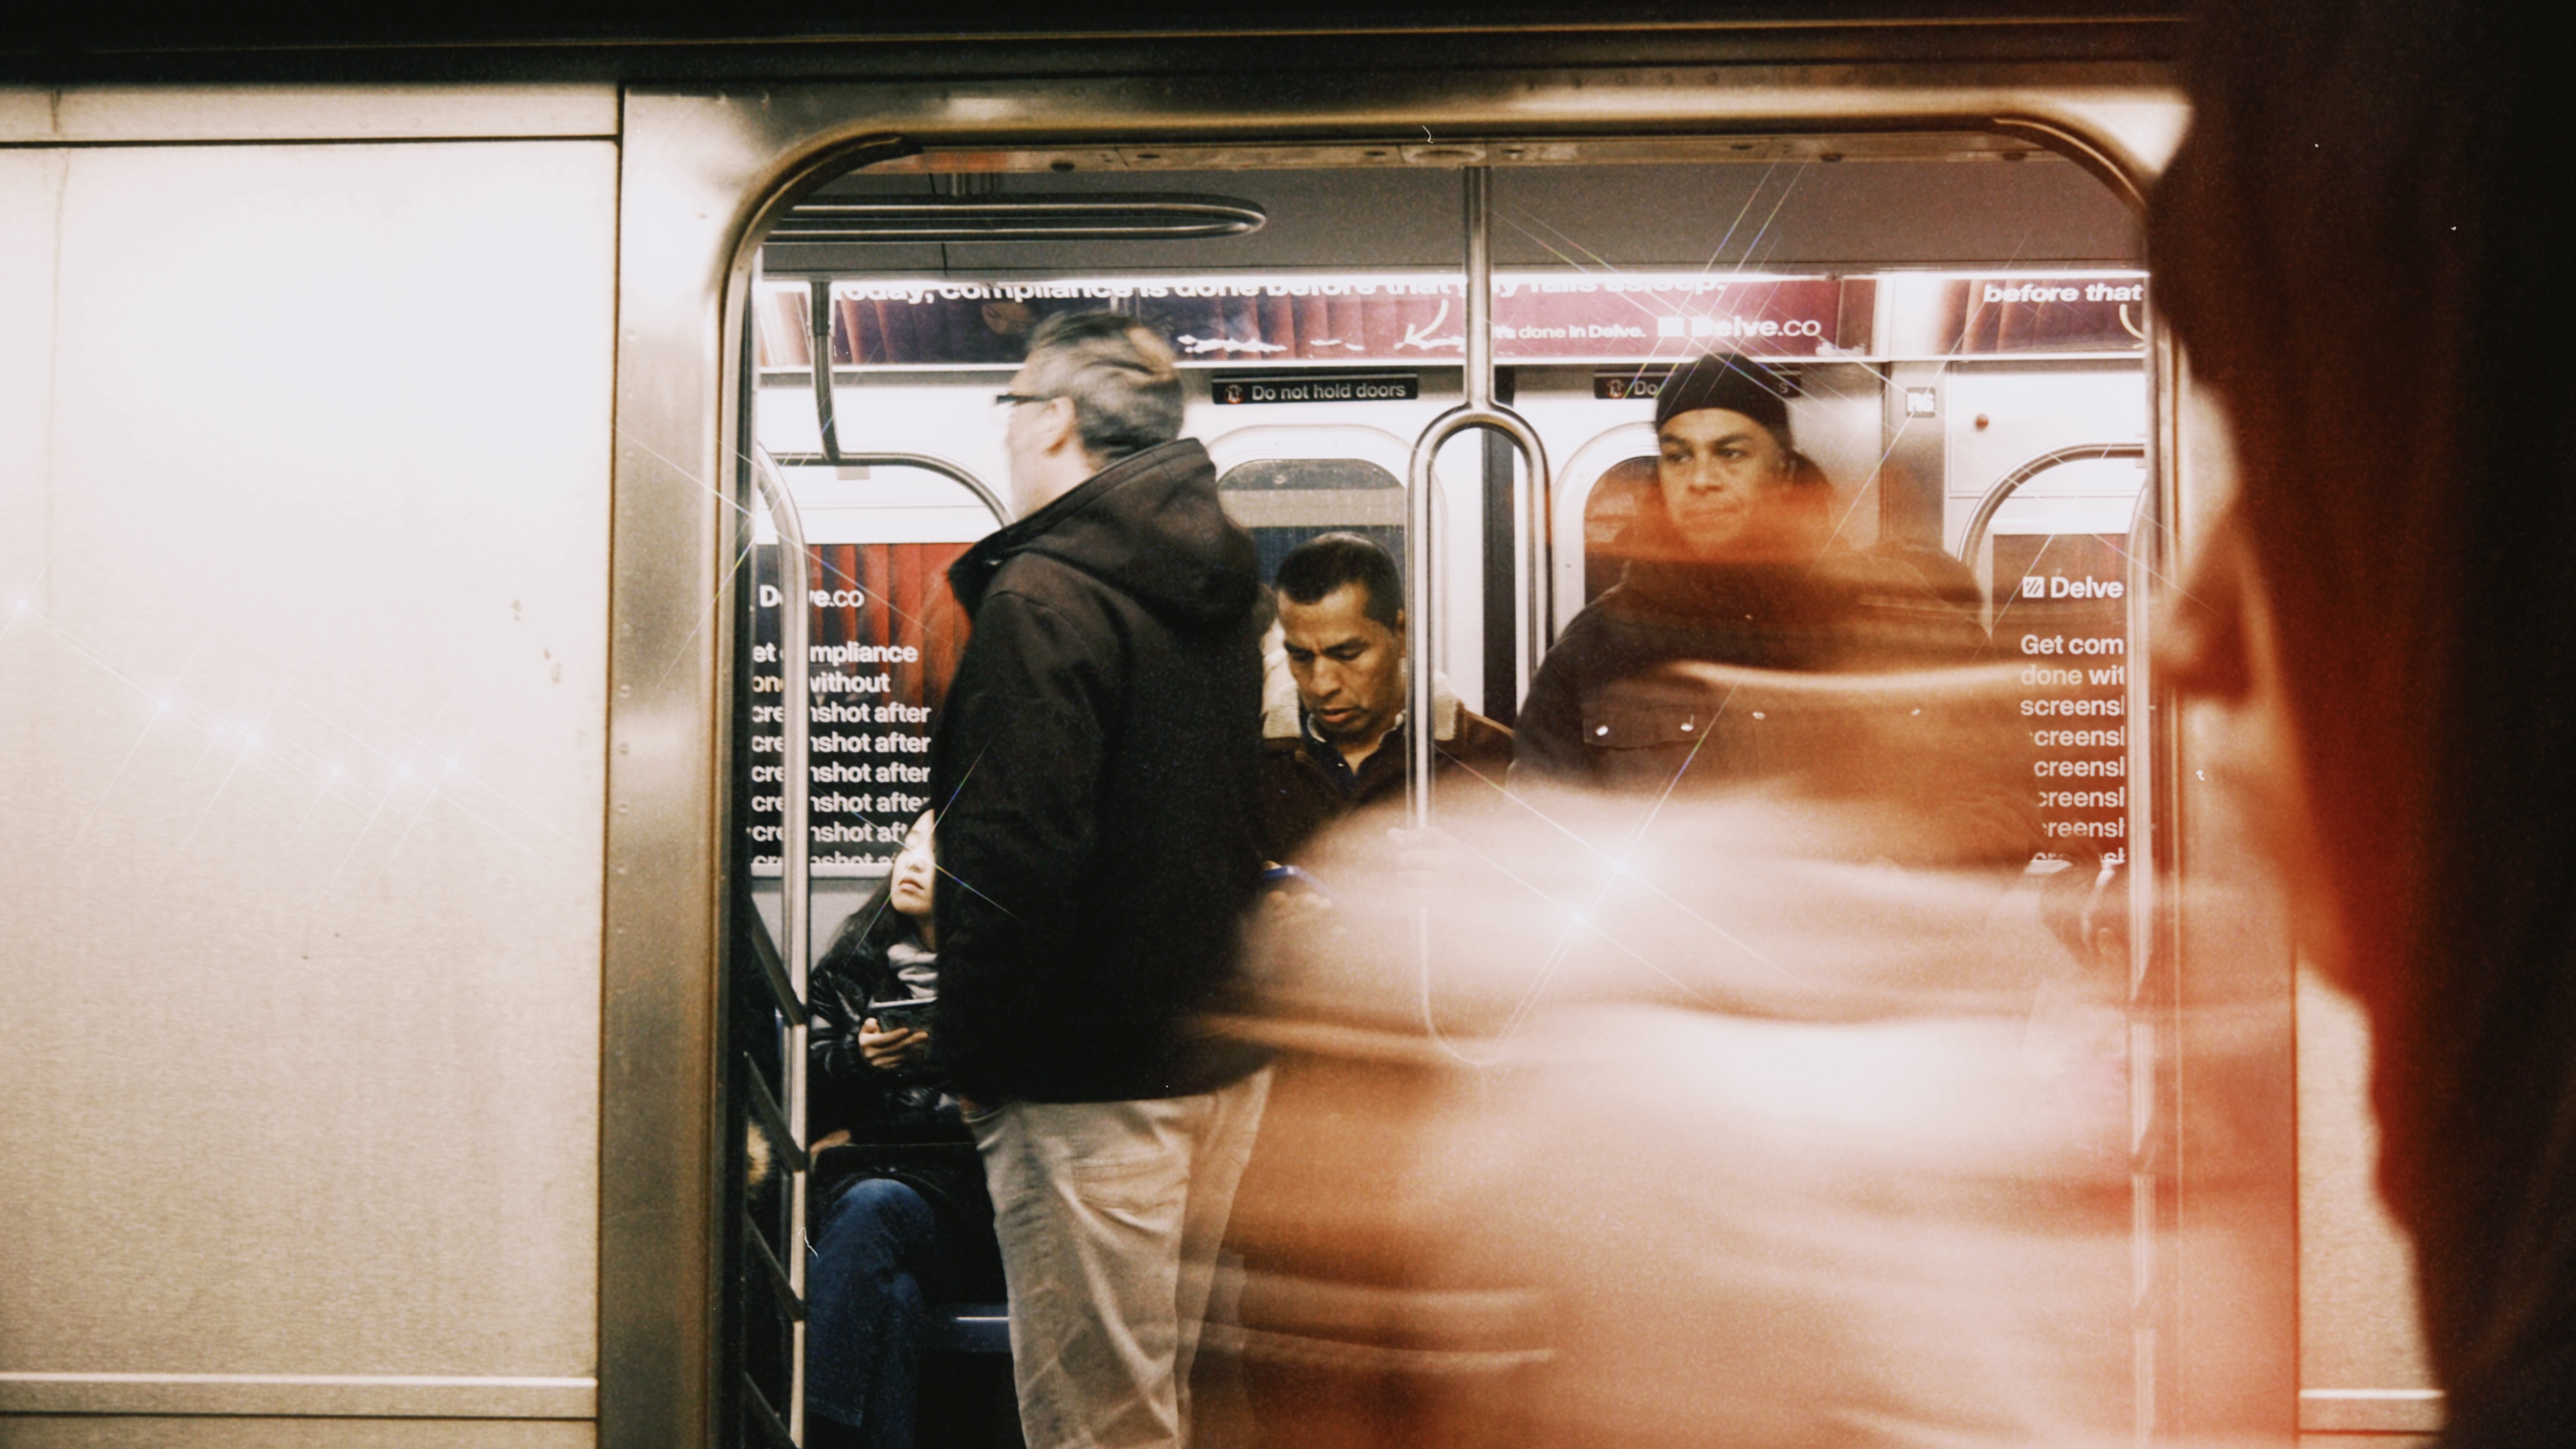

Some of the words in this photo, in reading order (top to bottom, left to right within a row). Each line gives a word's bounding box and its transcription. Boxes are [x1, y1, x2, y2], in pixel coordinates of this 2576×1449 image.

[1983, 284, 2080, 302] before
[2085, 283, 2144, 301] that
[1518, 326, 1566, 339] done
[1569, 325, 1586, 338] in
[1589, 324, 1646, 337] Delve.
[1691, 316, 1822, 336] Delve.co
[1252, 385, 1276, 400] Do
[1281, 386, 1309, 399] not
[1314, 384, 1351, 398] hold
[1356, 383, 1406, 398] doors
[1634, 381, 1658, 395] Do
[2051, 576, 2124, 598] Delve
[752, 642, 777, 663] et
[2021, 635, 2064, 654] Get
[2068, 638, 2124, 654] com
[2020, 664, 2082, 685] done
[2089, 665, 2125, 685] wit
[874, 702, 931, 722] after
[2020, 695, 2125, 715] screens
[875, 732, 931, 753] after
[2033, 726, 2125, 747] creens
[875, 762, 931, 782] after
[2033, 756, 2125, 777] creens
